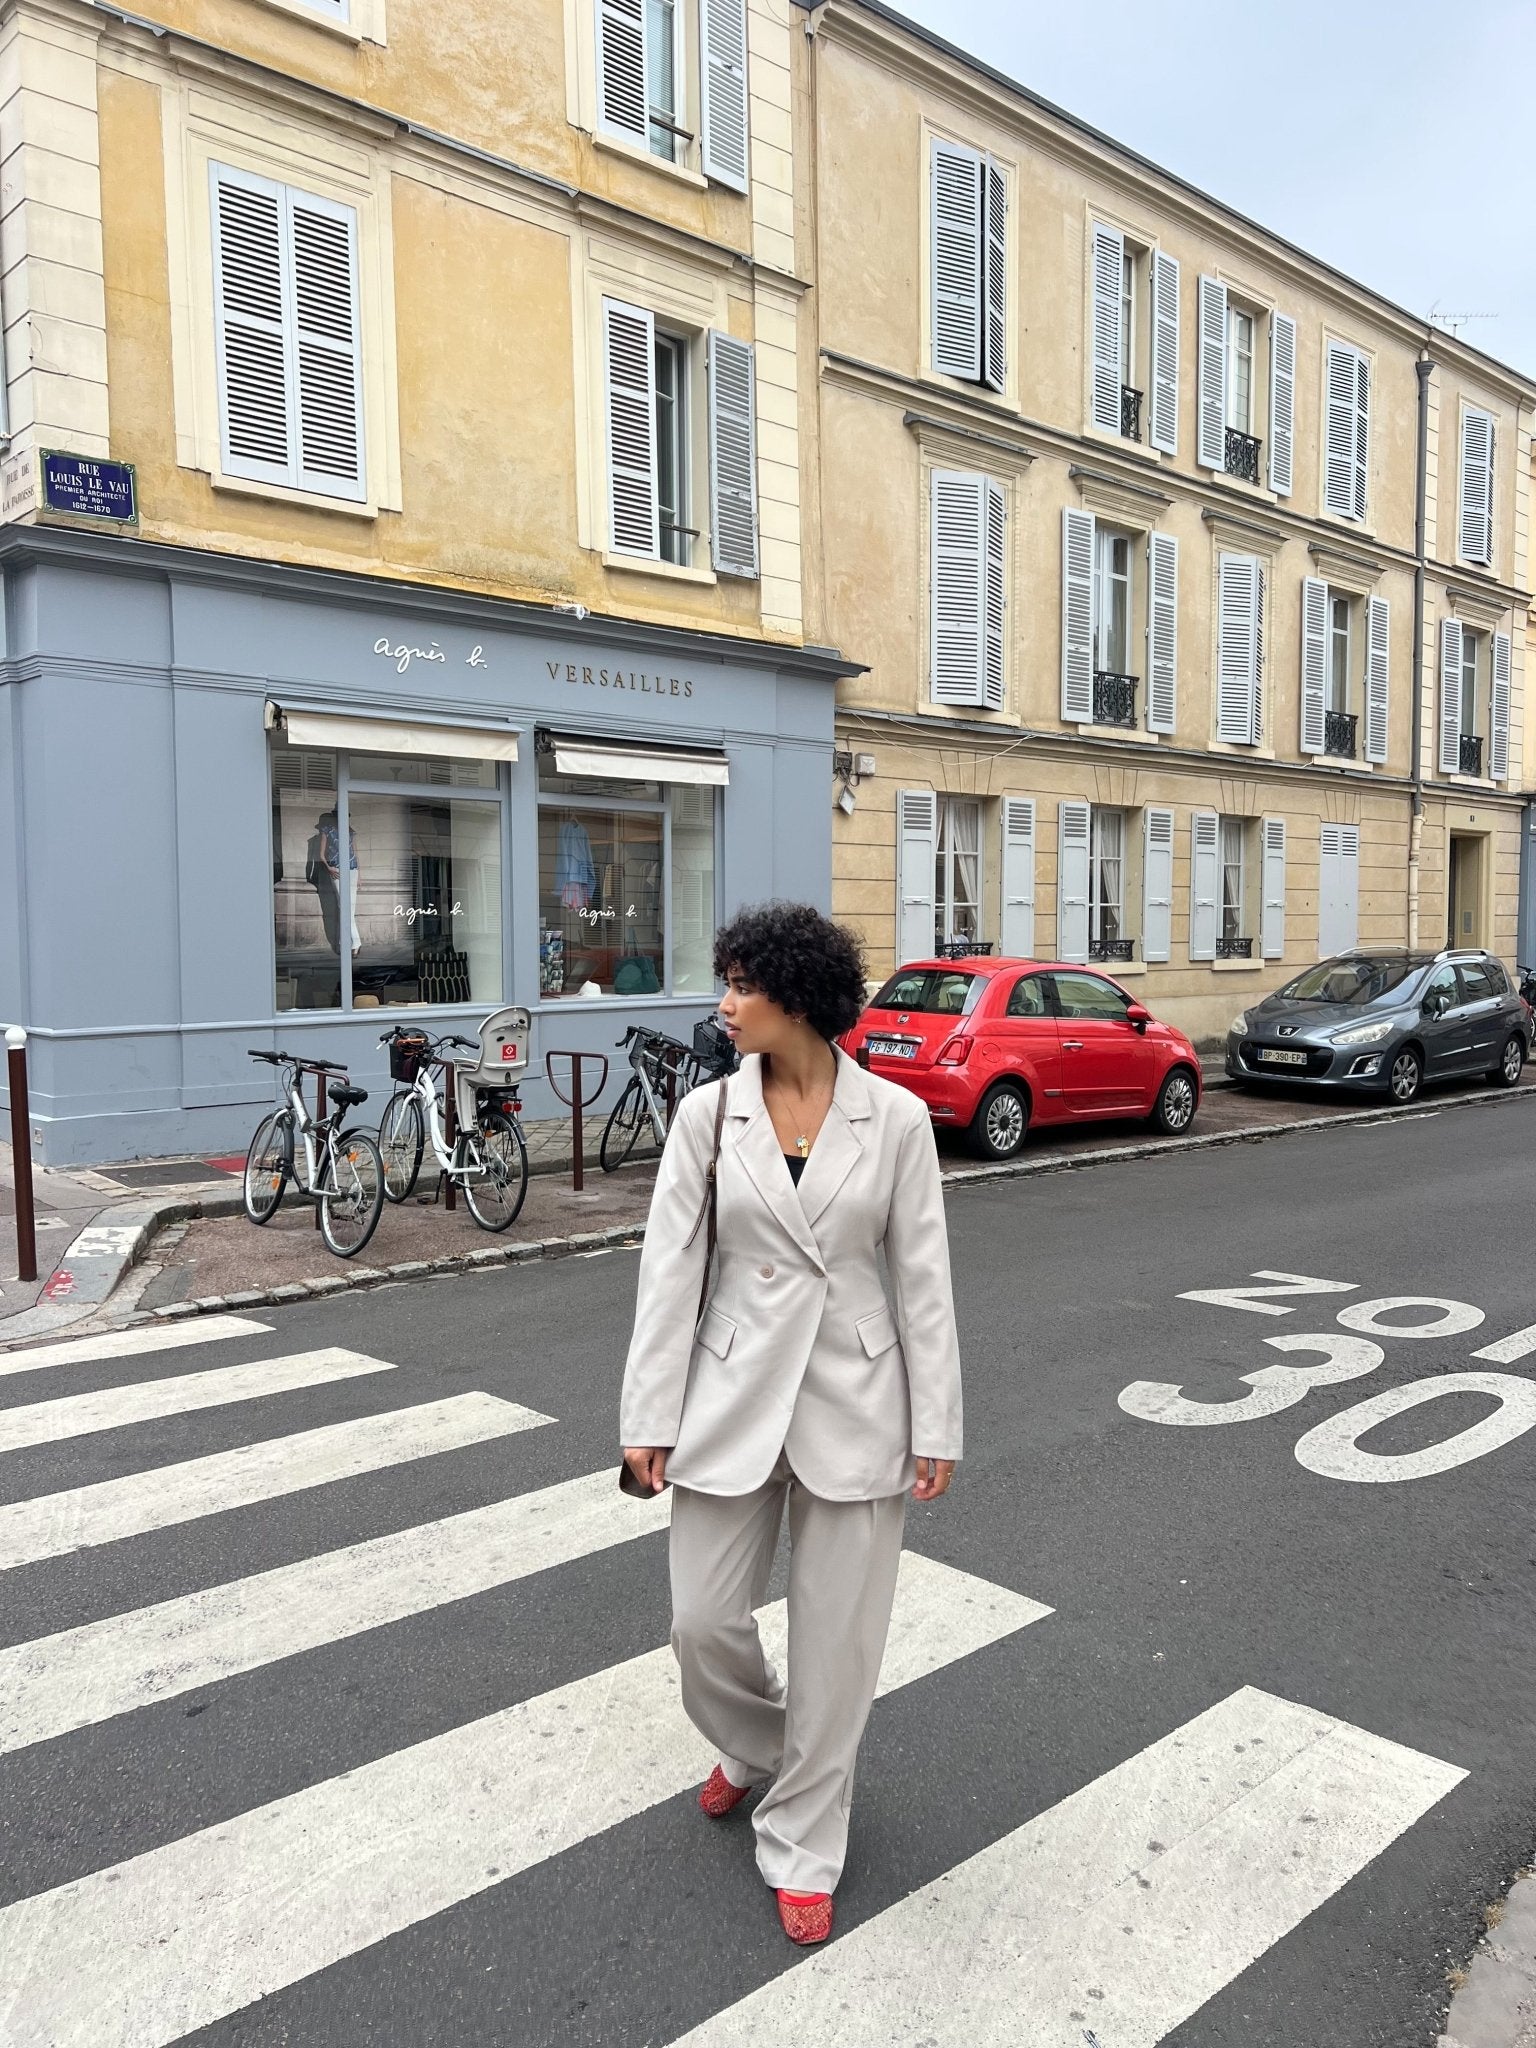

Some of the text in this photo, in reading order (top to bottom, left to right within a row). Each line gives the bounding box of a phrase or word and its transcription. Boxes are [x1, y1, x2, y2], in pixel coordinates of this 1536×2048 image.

[6, 469, 19, 486] RUE
[78, 462, 100, 477] RUE
[49, 471, 129, 494] LOUIS LE VAU
[54, 484, 126, 501] PREMIER ARCHITECTE
[79, 495, 103, 504] DU ROI
[374, 637, 446, 674] agnès
[546, 661, 693, 697] VERSAILLES
[393, 903, 438, 926] agnès
[579, 905, 616, 926] agnès
[1116, 1333, 1536, 1484] 30
